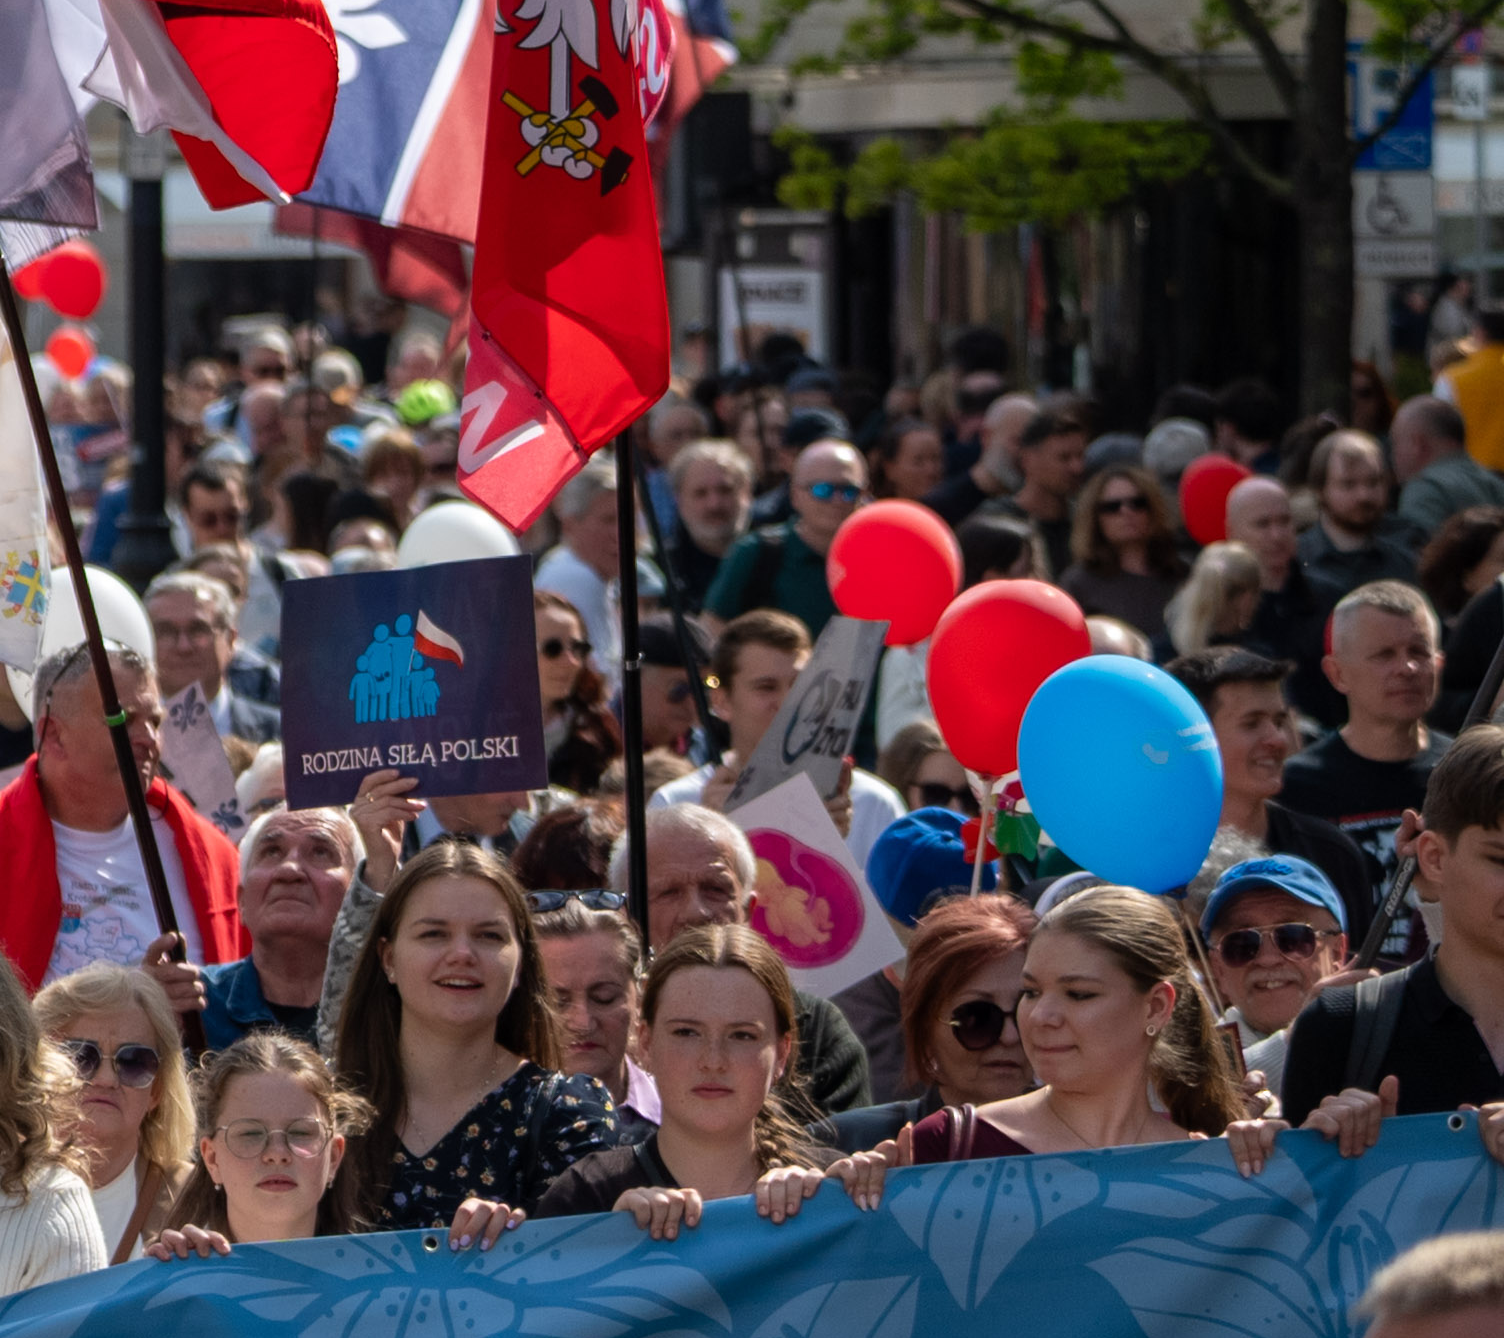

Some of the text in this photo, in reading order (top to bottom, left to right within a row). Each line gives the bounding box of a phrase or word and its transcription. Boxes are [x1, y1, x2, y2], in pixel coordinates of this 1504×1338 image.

[301, 736, 520, 775] RODZINA SIŁĄ POLSKI
